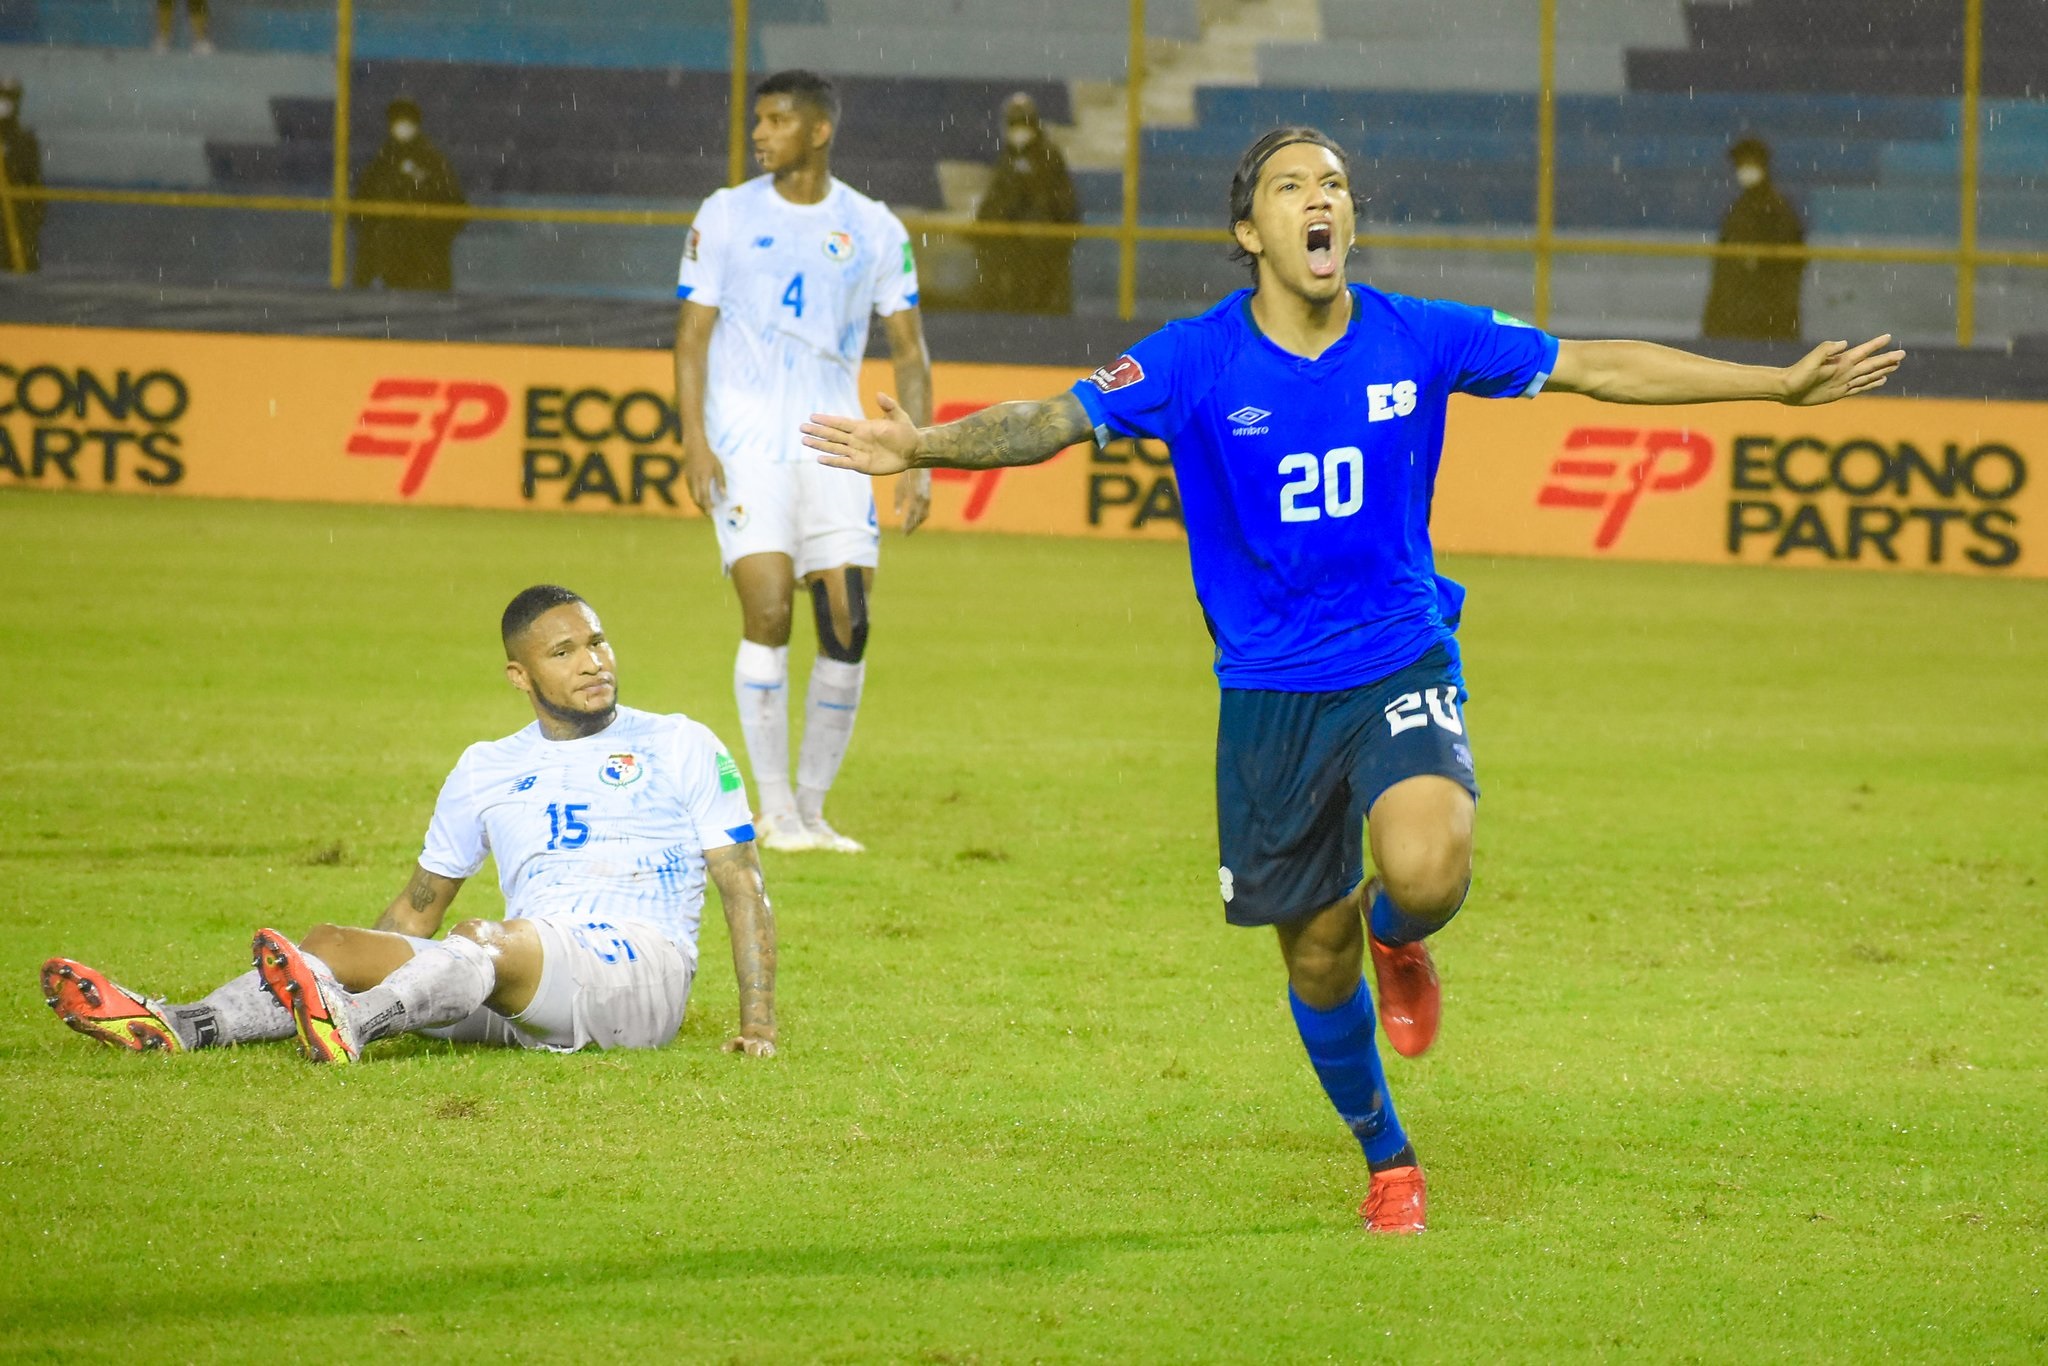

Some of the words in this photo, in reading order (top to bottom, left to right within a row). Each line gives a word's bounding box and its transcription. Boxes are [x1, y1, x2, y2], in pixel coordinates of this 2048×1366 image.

[782, 273, 804, 318] 4
[1232, 426, 1270, 437] umbro
[1278, 446, 1364, 523] 20
[1731, 435, 2027, 501] ECONO
[1728, 500, 2022, 567] PARTS
[546, 802, 591, 850] 15
